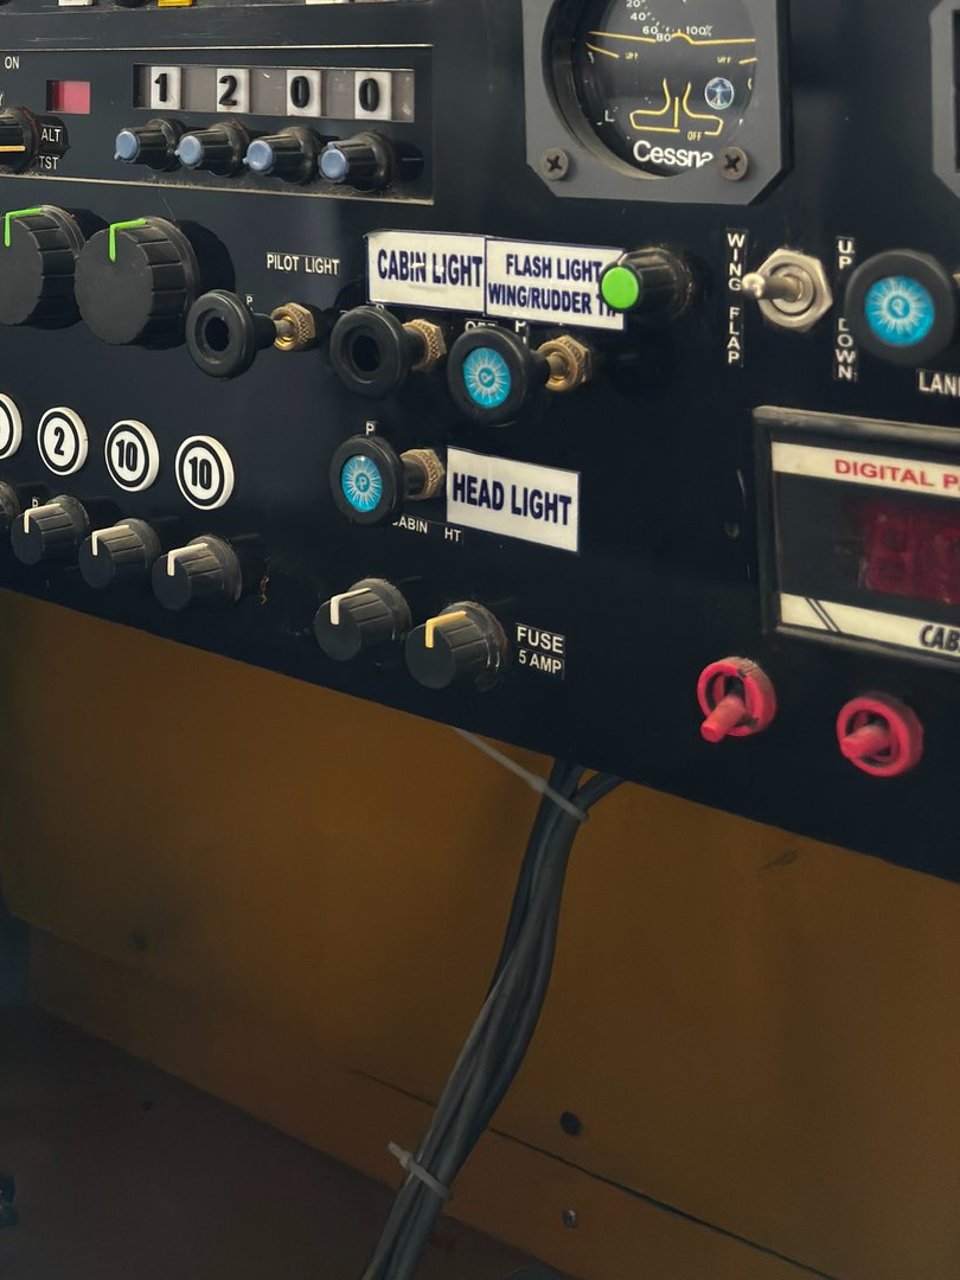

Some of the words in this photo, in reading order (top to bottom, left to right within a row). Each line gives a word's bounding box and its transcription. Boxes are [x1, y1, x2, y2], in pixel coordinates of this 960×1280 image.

[630, 12, 646, 21] 40
[642, 26, 658, 34] 60
[656, 34, 672, 42] 80
[686, 26, 712, 36] 100%
[5, 56, 19, 70] ON
[41, 128, 61, 142] ALT
[39, 156, 59, 170] TST
[267, 254, 300, 271] PILOT
[305, 257, 340, 275] LIGHT
[506, 254, 552, 278] FLASH
[558, 256, 602, 282] LIGHT
[838, 240, 853, 270] UP
[378, 250, 426, 282] CABIN
[432, 254, 483, 287] LIGHT
[488, 283, 592, 315] WING/RUDDER
[919, 371, 960, 397] LAN
[54, 427, 65, 455] 2
[116, 440, 138, 471] 10
[188, 458, 211, 490] 10
[834, 459, 934, 487] DIGITAL
[452, 473, 504, 511] HEAD
[512, 485, 572, 526] LIGHT
[392, 516, 428, 534] ABIN
[516, 626, 564, 652] FUSE
[920, 624, 960, 652] CAB
[519, 650, 527, 663] 5
[530, 653, 562, 674] AMP
